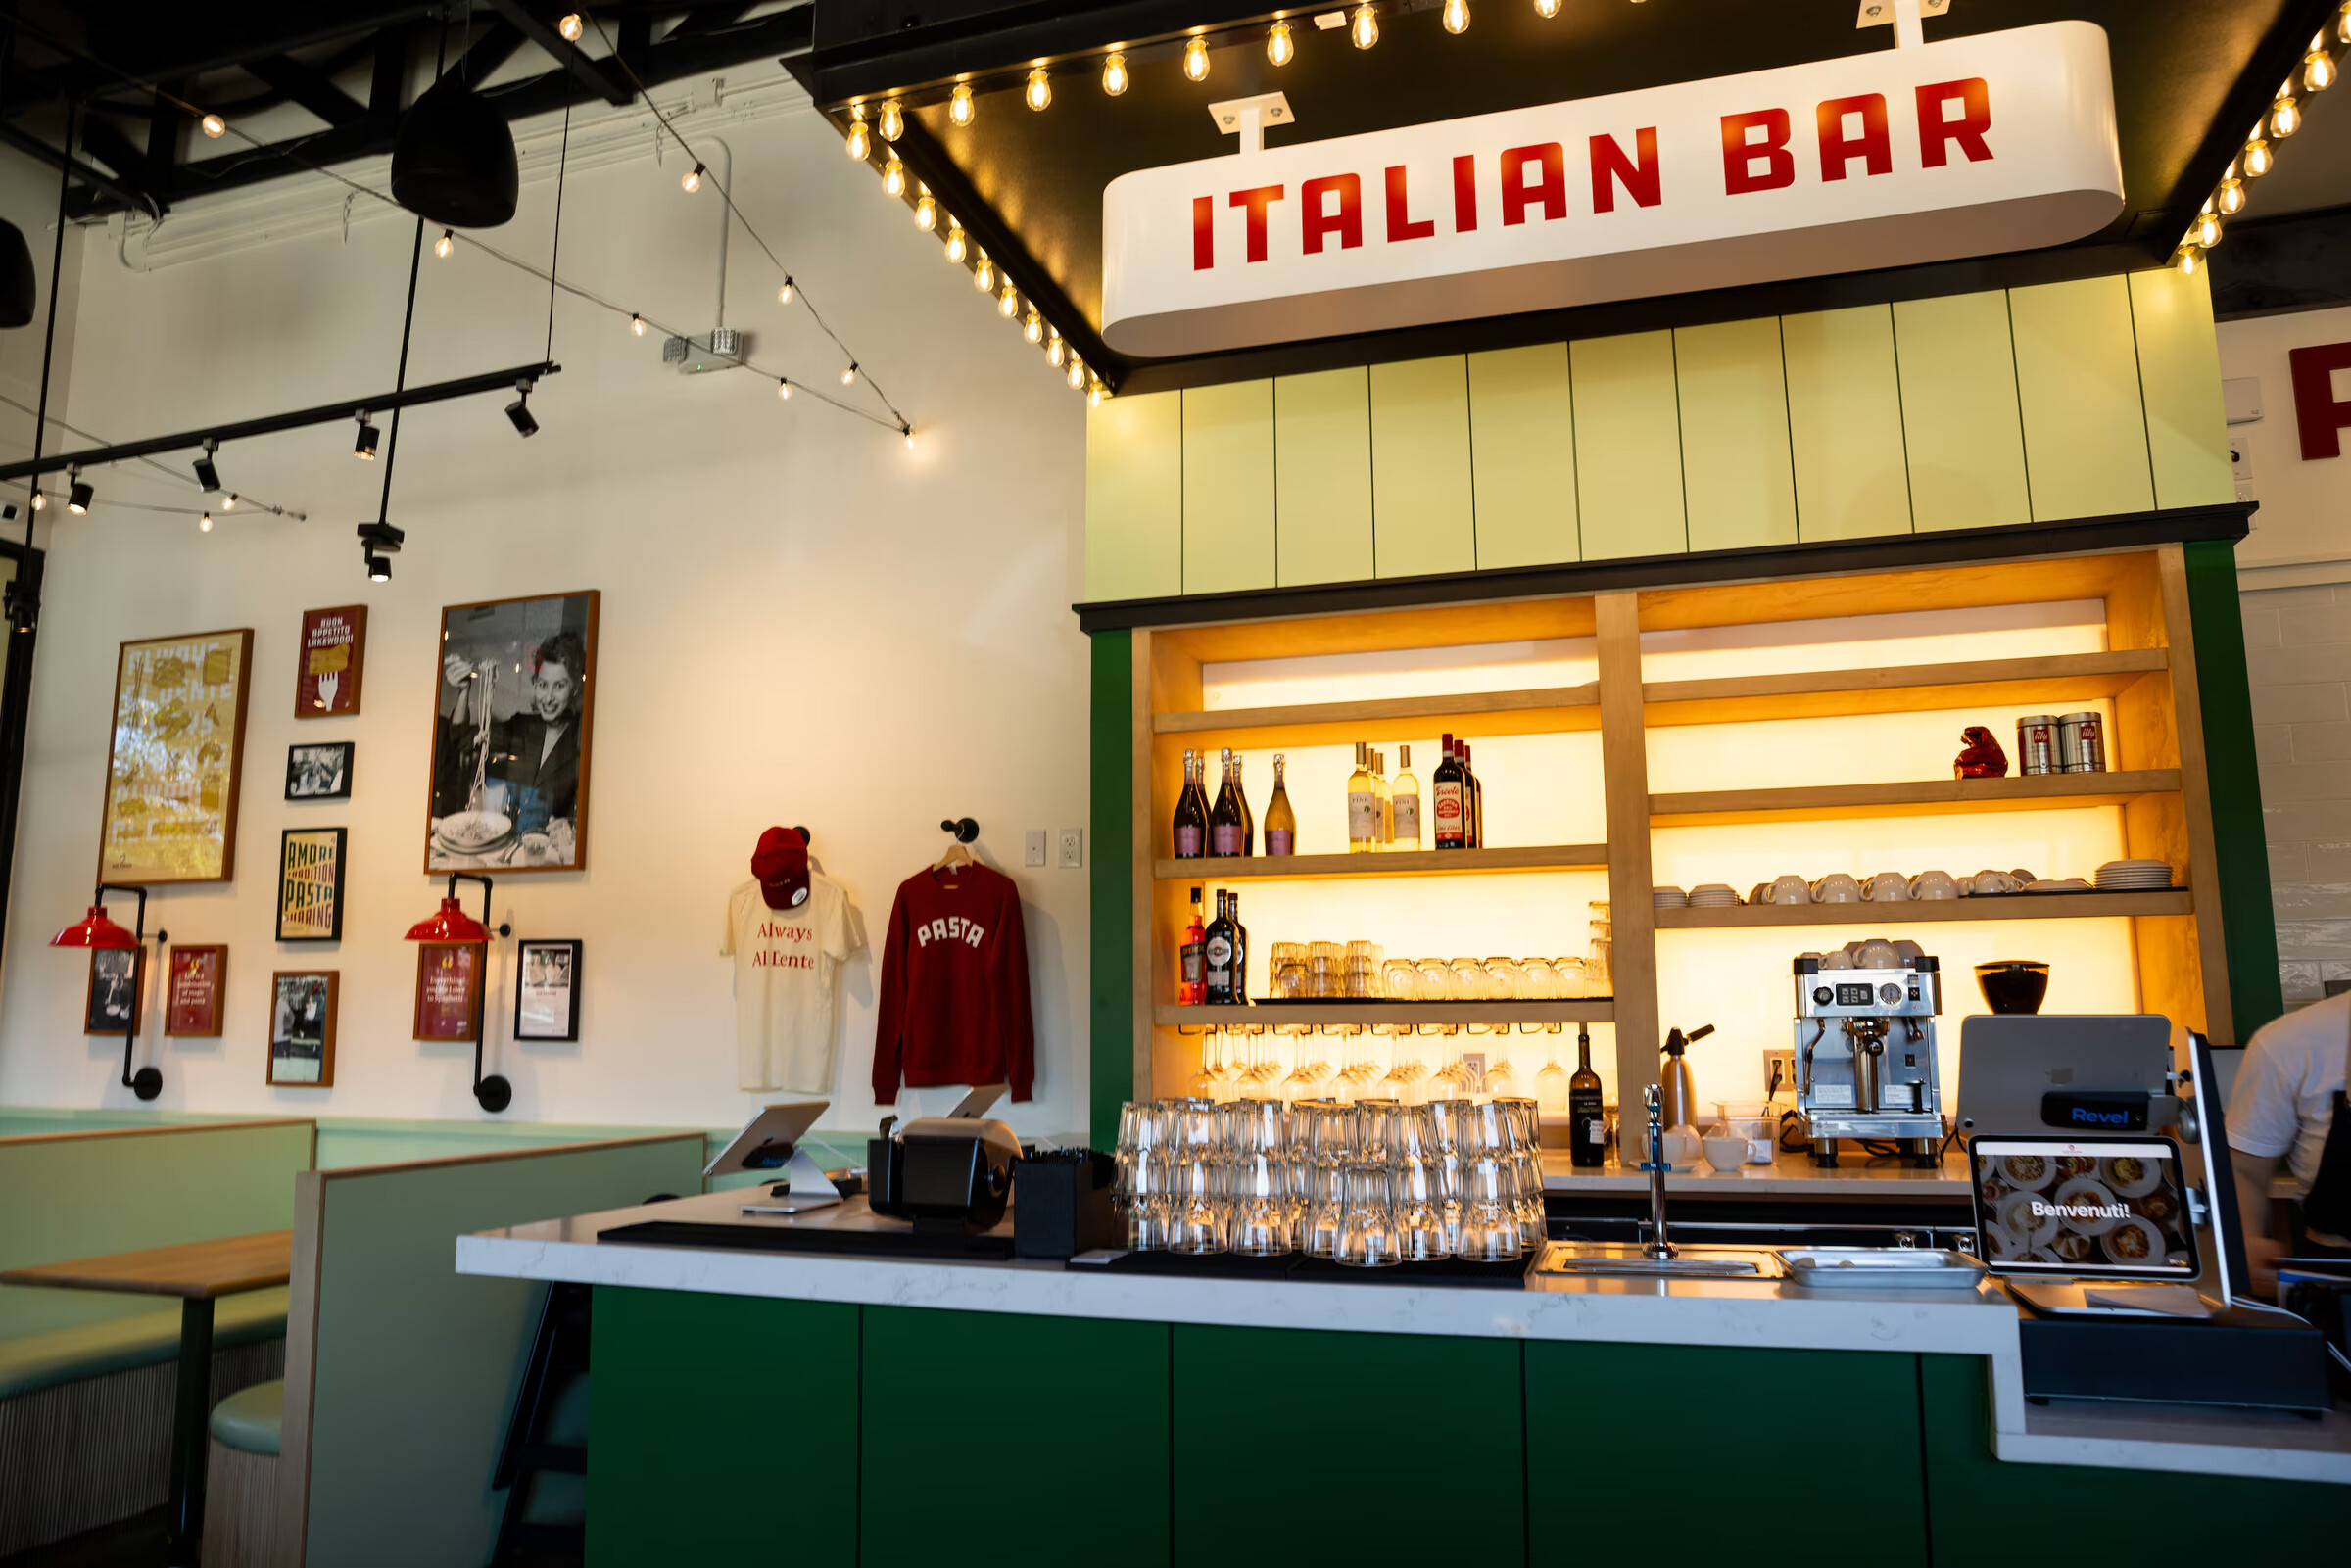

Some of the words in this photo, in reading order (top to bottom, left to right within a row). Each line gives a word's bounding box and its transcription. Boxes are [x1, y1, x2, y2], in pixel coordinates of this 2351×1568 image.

[1192, 125, 1662, 271] ITALIAN
[1720, 76, 1994, 196] BAR
[320, 616, 343, 628] BUON
[307, 634, 354, 648] LAKEWOOD!
[312, 625, 351, 639] APPETITO
[2034, 731, 2048, 741] illy
[2082, 728, 2095, 738] illy
[288, 841, 334, 870] AMORE
[285, 879, 333, 911] PASTA
[757, 921, 813, 943] Always
[917, 915, 984, 948] PASTA
[752, 949, 767, 968] Al
[2071, 1107, 2129, 1124] Revel
[2031, 1201, 2131, 1219] Benvenuti!
